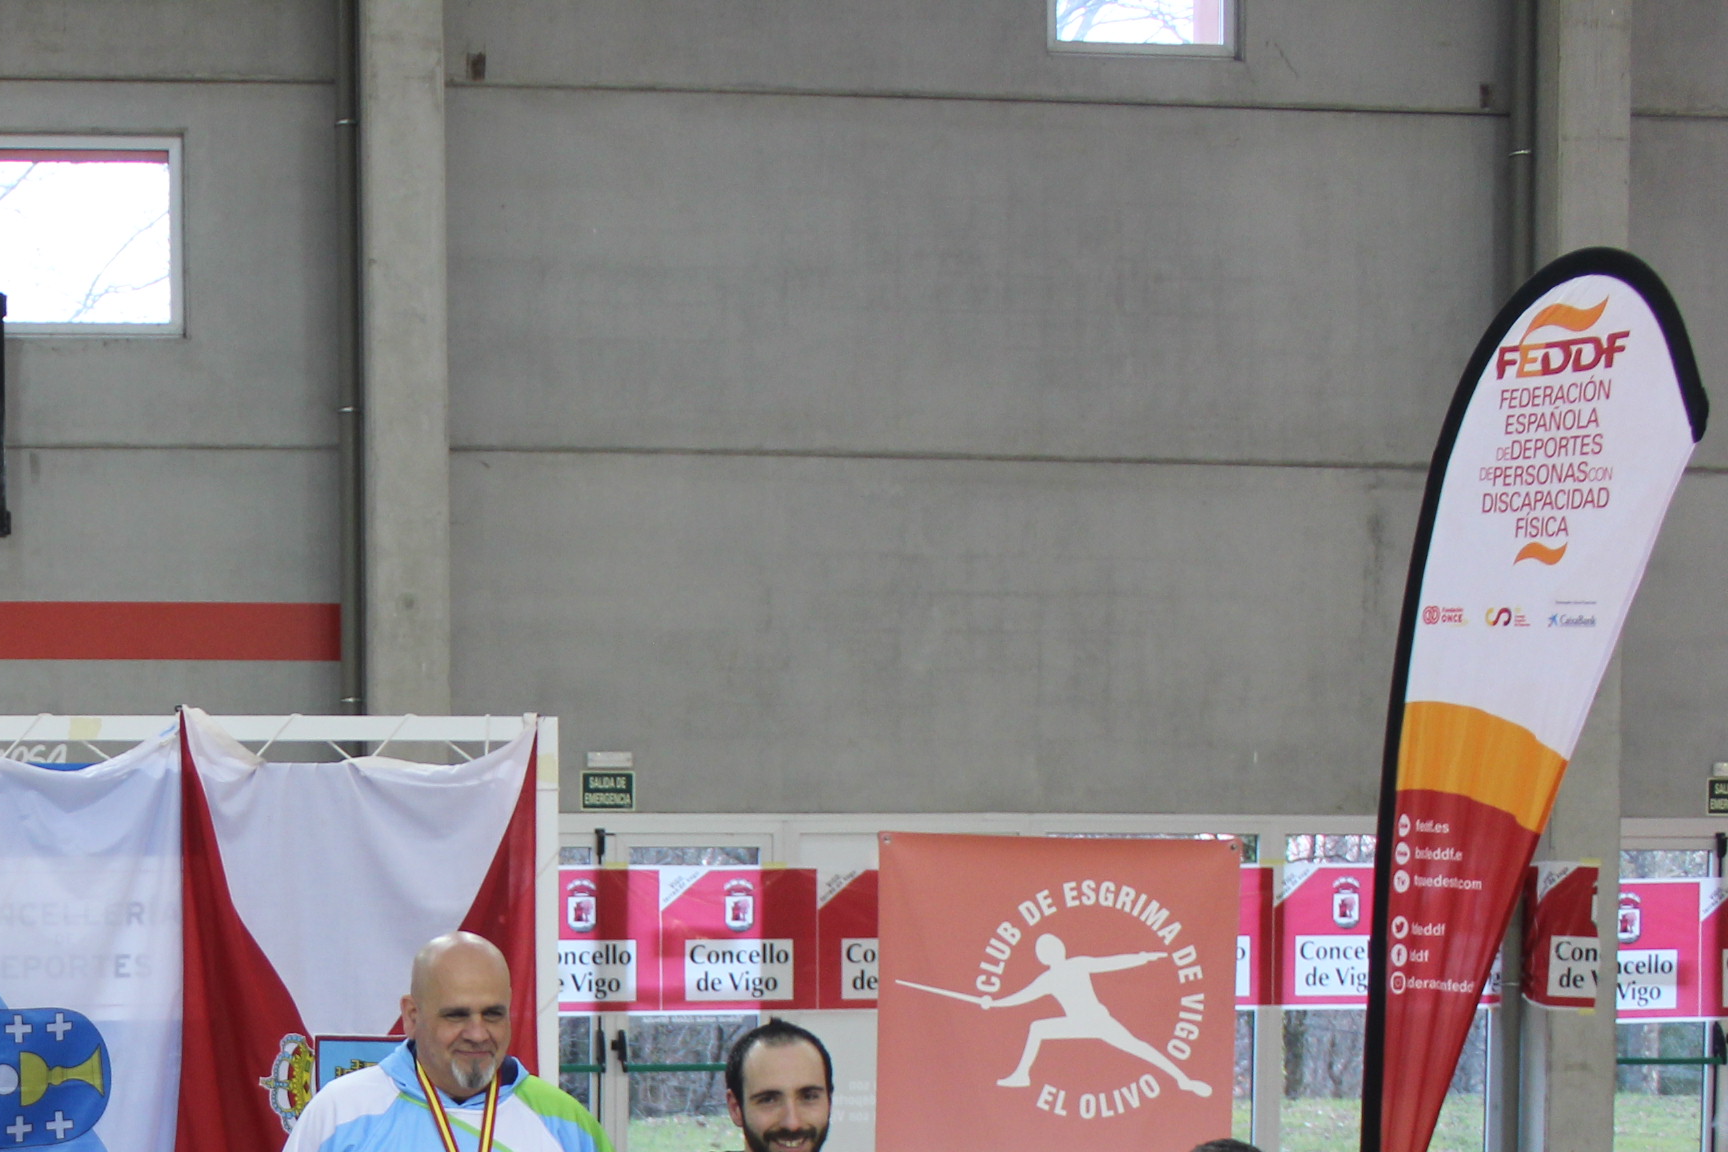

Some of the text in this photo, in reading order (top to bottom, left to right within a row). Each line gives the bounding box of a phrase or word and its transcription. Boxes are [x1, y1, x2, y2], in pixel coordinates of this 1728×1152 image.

[1496, 331, 1630, 380] FEDDF
[1499, 375, 1612, 410] FEDERACIÓN
[1504, 406, 1599, 435] ESPAÑOLA
[1482, 487, 1610, 513] DISCAPACIDAD
[1515, 511, 1569, 538] FÍSICA
[589, 776, 627, 789] SALIDA DE
[585, 792, 631, 805] EMERGENCIA
[689, 943, 789, 966] Concello
[846, 943, 876, 963] Co
[1300, 940, 1369, 961] Conce
[1555, 941, 1598, 961] Con
[852, 970, 878, 991] de
[976, 879, 1204, 1061] CLUB DE ESGRIMA DE VIGO
[1305, 967, 1369, 993] de Vig
[1559, 967, 1584, 988] de
[571, 972, 621, 999] Vigo
[696, 970, 778, 998] de Vigo
[1036, 1073, 1161, 1119] EL OLIVO
